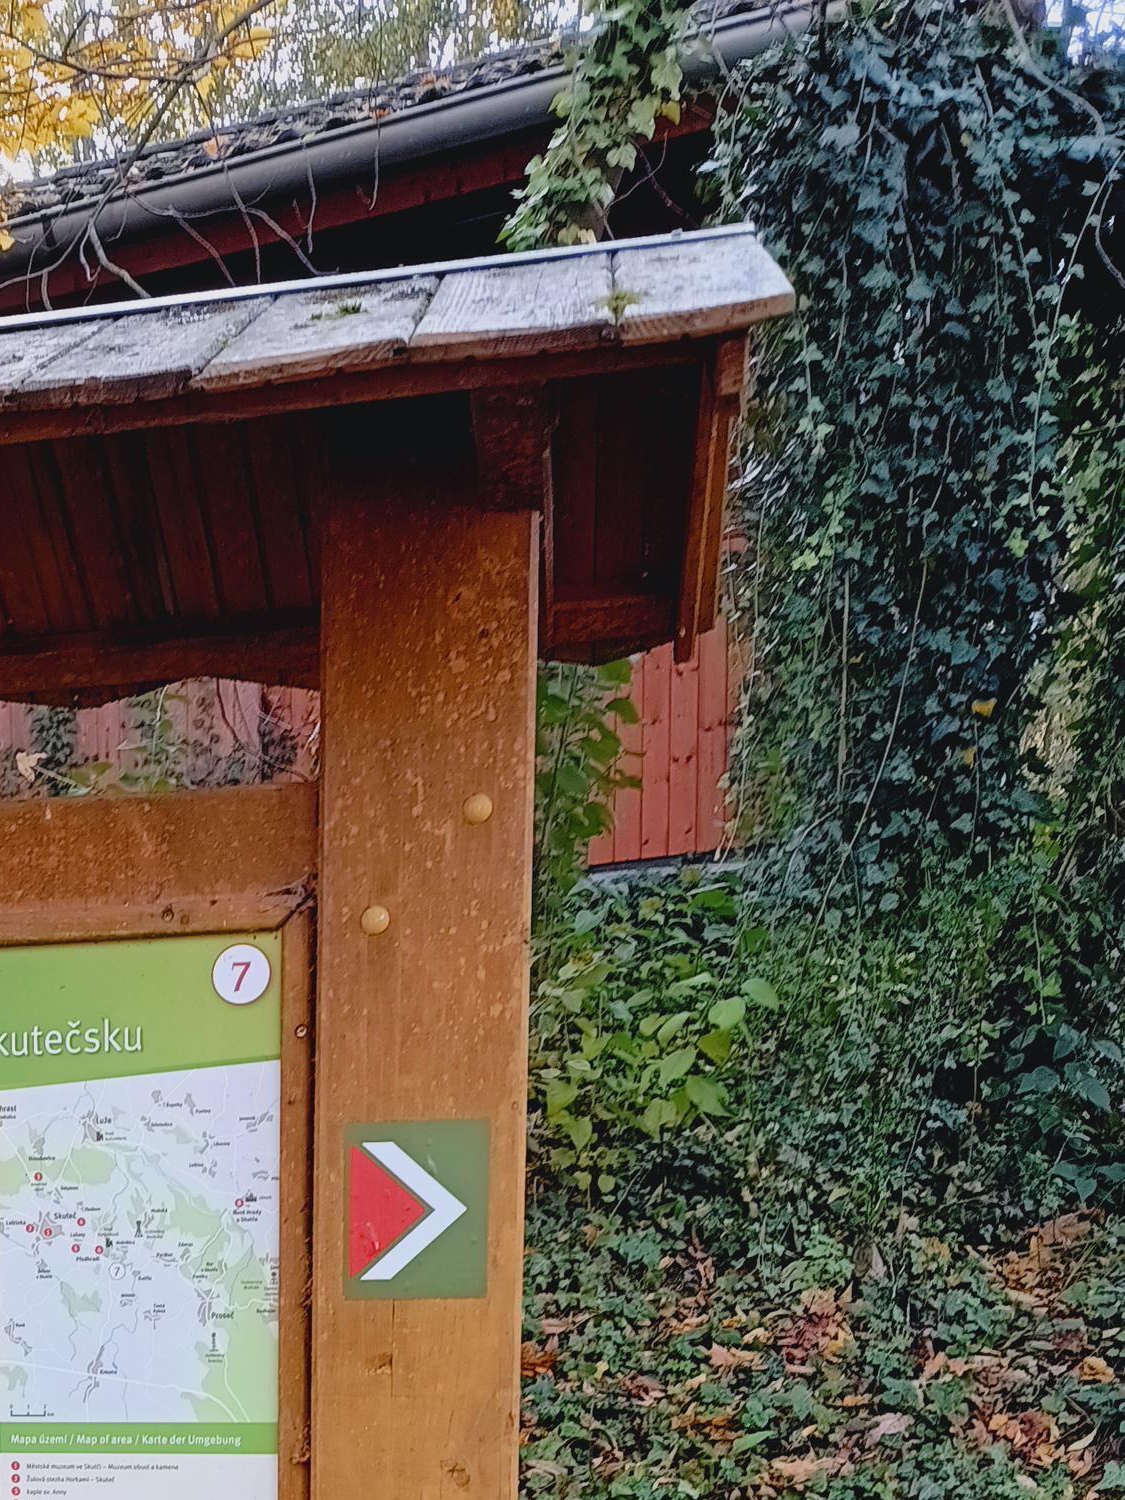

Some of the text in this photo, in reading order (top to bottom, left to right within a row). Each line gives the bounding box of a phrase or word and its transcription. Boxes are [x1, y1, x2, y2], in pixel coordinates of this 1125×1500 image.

[230, 961, 252, 992] 7
[10, 1434, 36, 1445] Mapa
[38, 1433, 67, 1444] území
[76, 1434, 98, 1446] Map
[98, 1434, 109, 1444] of
[110, 1436, 132, 1444] area
[141, 1434, 167, 1444] Karte
[169, 1434, 186, 1444] der
[187, 1434, 241, 1446] Umgebung
